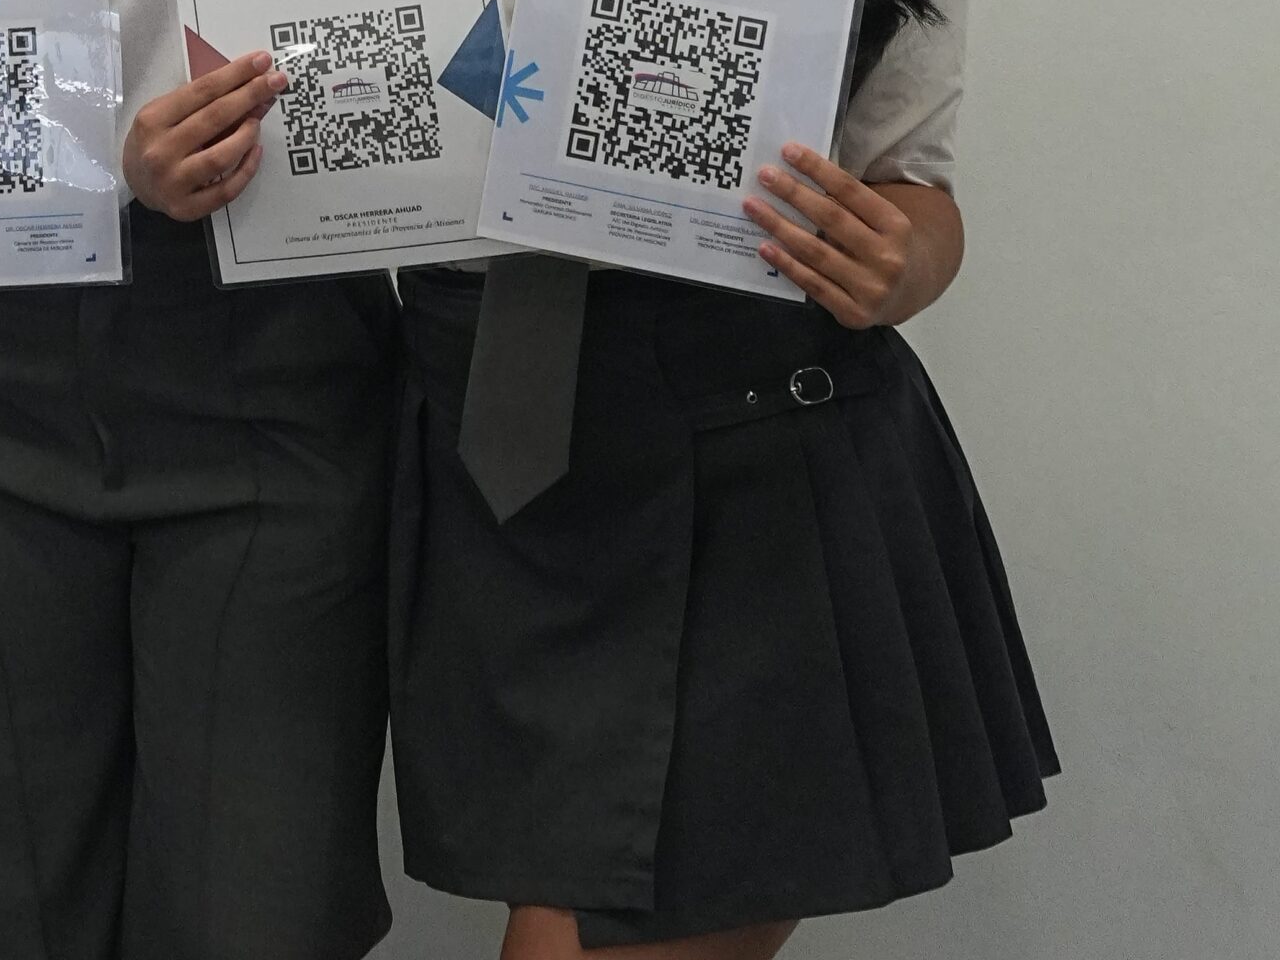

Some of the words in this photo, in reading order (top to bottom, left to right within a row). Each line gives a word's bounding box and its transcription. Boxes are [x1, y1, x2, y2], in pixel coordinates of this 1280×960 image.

[320, 215, 332, 223] DR.
[334, 212, 359, 222] OSCAR
[360, 208, 393, 219] HERRERA
[395, 205, 422, 215] AHUAD
